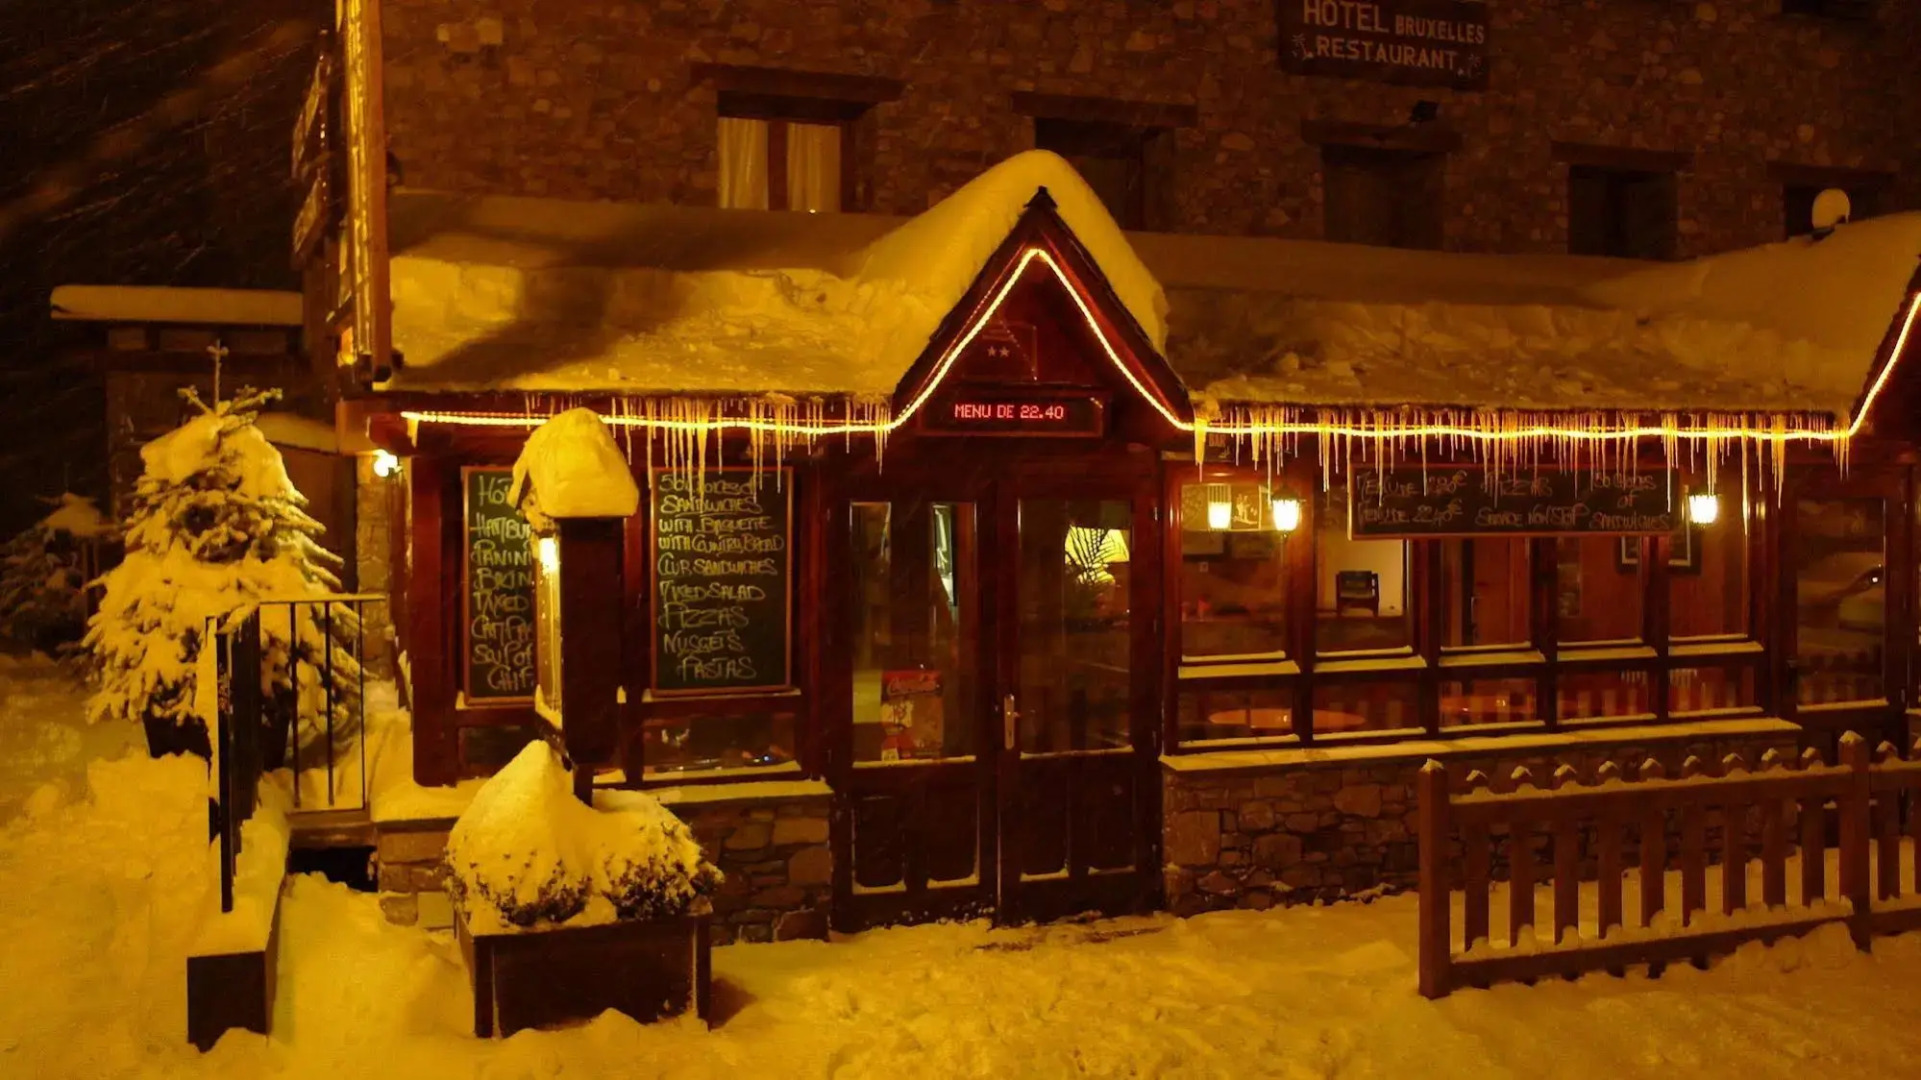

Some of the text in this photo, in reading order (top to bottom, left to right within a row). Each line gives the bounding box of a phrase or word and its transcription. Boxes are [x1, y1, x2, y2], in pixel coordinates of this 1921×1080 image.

[1303, 0, 1485, 45] HOTEL BRUXELLES
[1315, 34, 1458, 71] RESTAURANT
[954, 404, 1065, 420] MENU DE 22.40
[658, 518, 693, 534] WITH
[658, 534, 691, 551] WITH
[706, 581, 766, 601] SALAD
[658, 601, 749, 630] PIZZAS
[663, 628, 744, 658] NUGGETS
[676, 655, 757, 683] PASTAS
